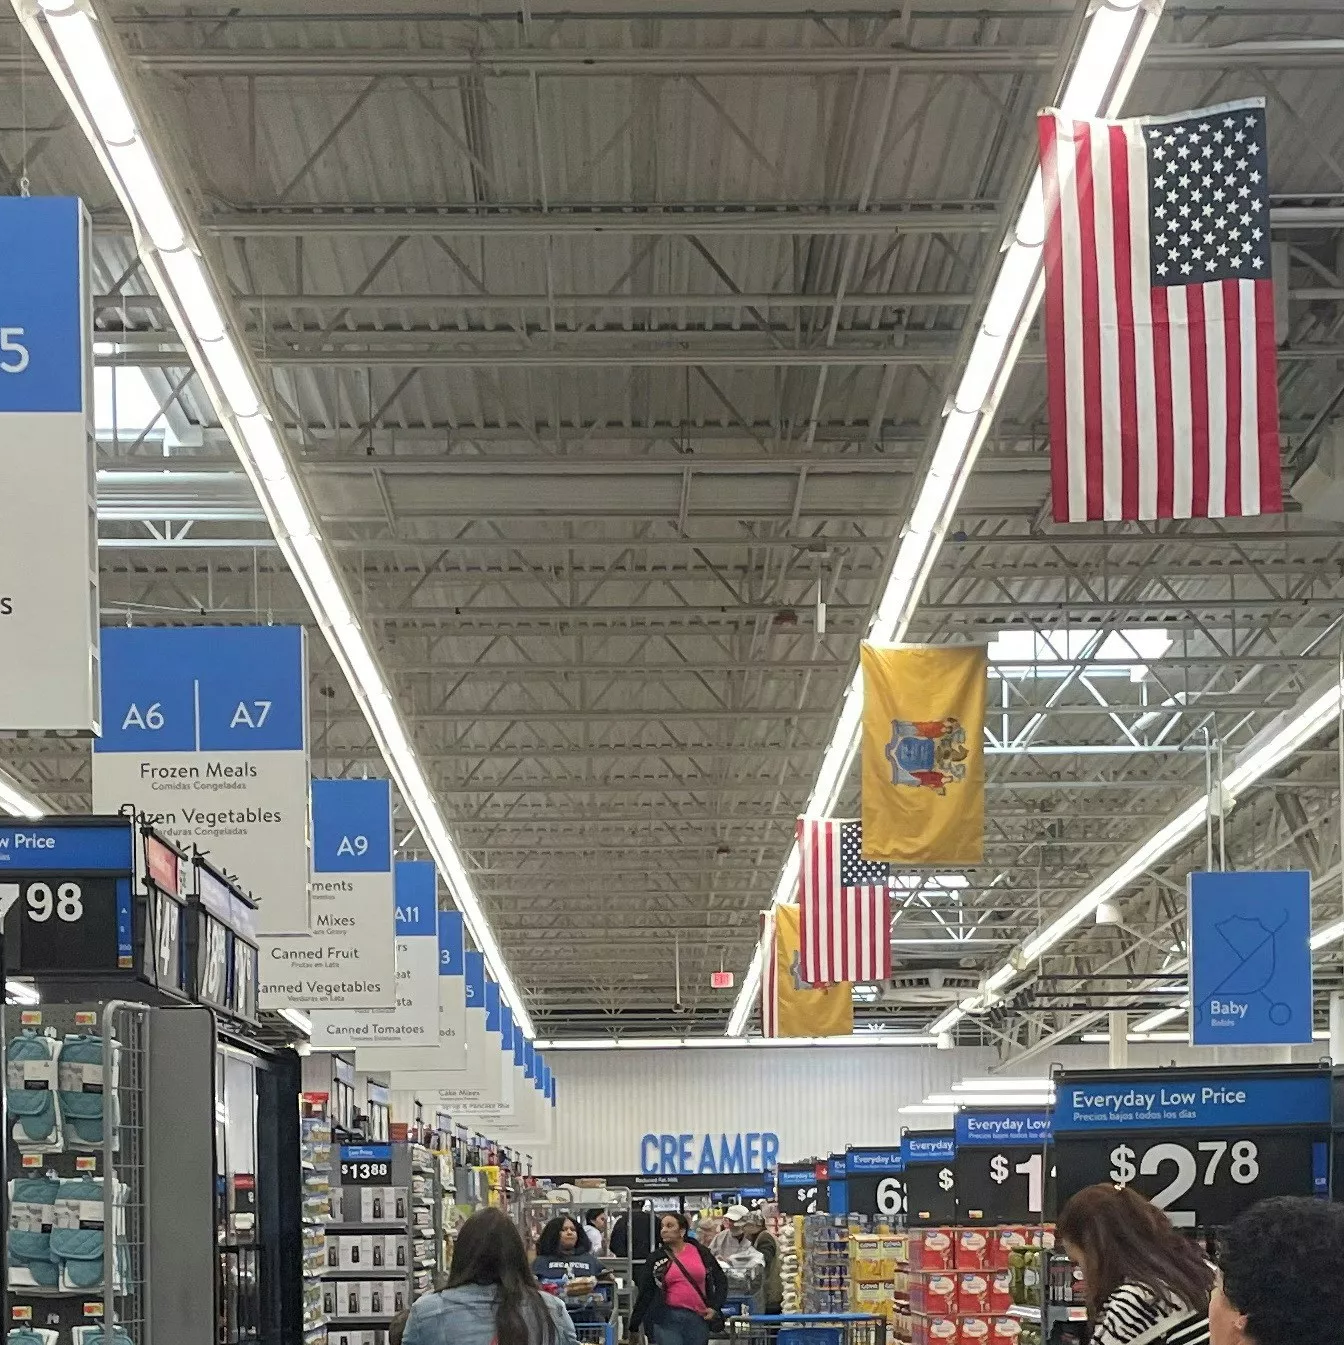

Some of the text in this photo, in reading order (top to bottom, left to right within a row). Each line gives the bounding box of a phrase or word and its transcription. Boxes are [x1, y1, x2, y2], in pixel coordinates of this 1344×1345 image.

[122, 701, 272, 730] A6 A7
[140, 762, 257, 778] Frozen Meals
[134, 808, 282, 827] ozen Vegetables
[15, 833, 56, 849] Price
[337, 835, 368, 856] A9
[312, 881, 353, 892] ments
[317, 914, 355, 926] Mixes
[395, 906, 419, 923] A11
[271, 947, 360, 959] Canned Fruit
[258, 981, 381, 996] anned Vegetables
[1210, 1000, 1249, 1018] Baby
[326, 1024, 424, 1035] Canned Tomatoes
[1072, 1087, 1246, 1111] Everyday Low Price
[1073, 1112, 1106, 1121] Precios
[1110, 1111, 1133, 1122] bajos
[1135, 1110, 1161, 1120] todos
[1163, 1110, 1176, 1119] los
[968, 1117, 1023, 1132] Everyday
[641, 1133, 779, 1174] CREAMER
[910, 1141, 953, 1152] Everyday
[854, 1154, 889, 1166] Everyday
[990, 1154, 1056, 1212] $1
